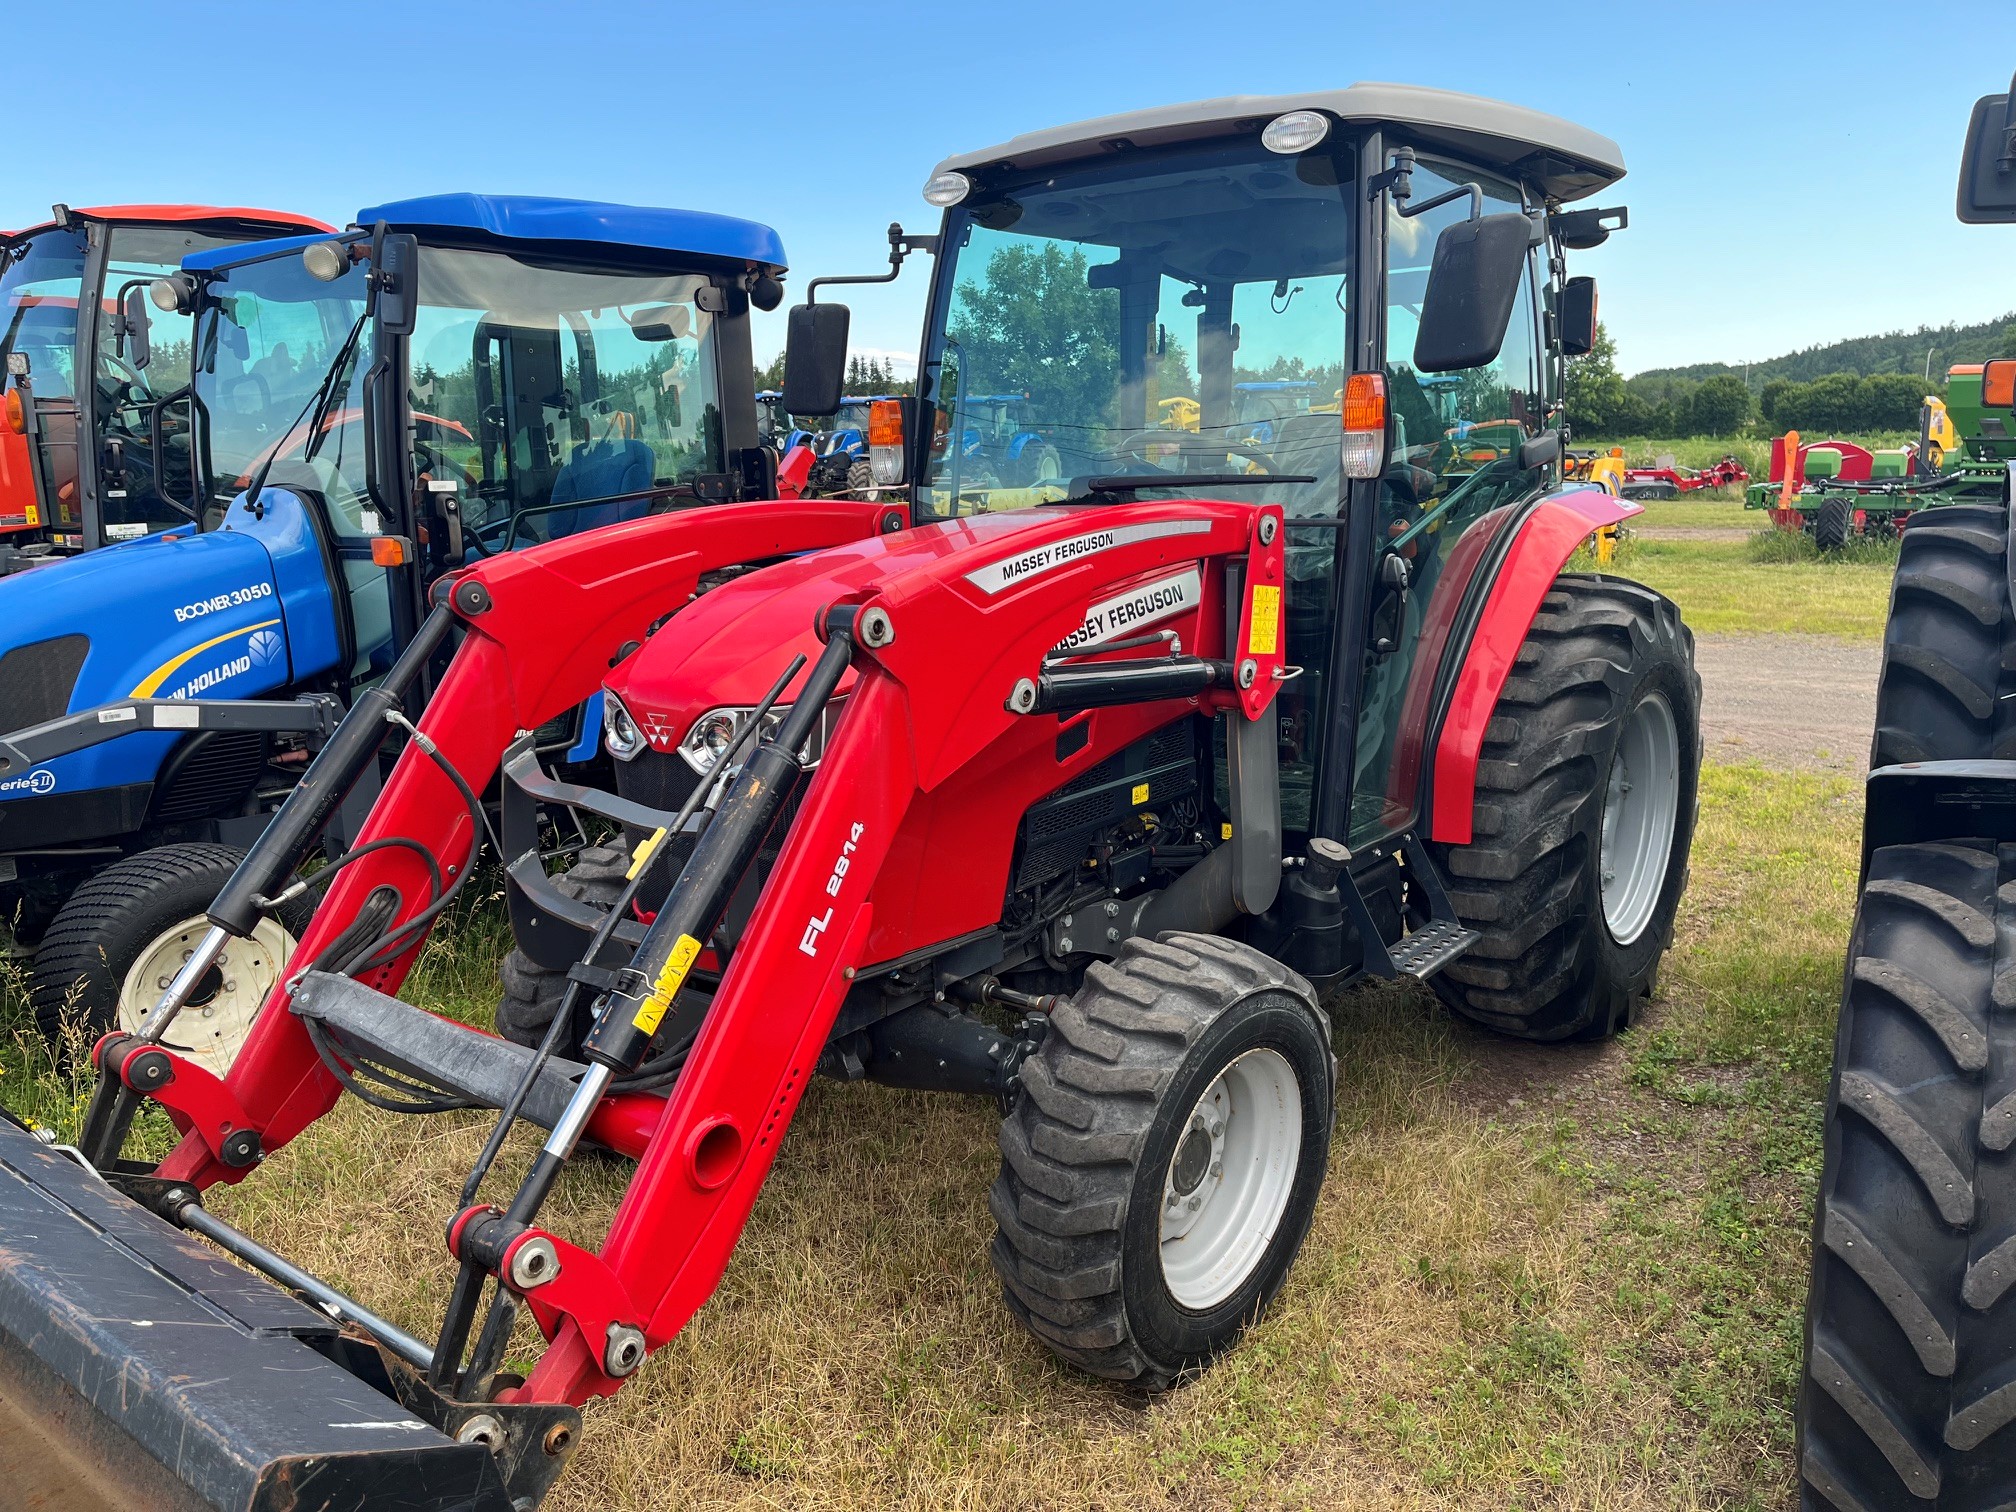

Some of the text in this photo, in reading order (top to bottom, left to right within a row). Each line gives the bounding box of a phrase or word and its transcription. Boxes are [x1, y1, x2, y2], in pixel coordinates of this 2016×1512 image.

[1002, 532, 1113, 580] MASSEY FERGUSON
[173, 582, 272, 623] BOOMER 3050
[1050, 584, 1184, 651] ASSEY FERGUSON
[187, 655, 251, 698] HOLLAND
[0, 778, 39, 791] eries
[798, 821, 864, 957] FL 2814
